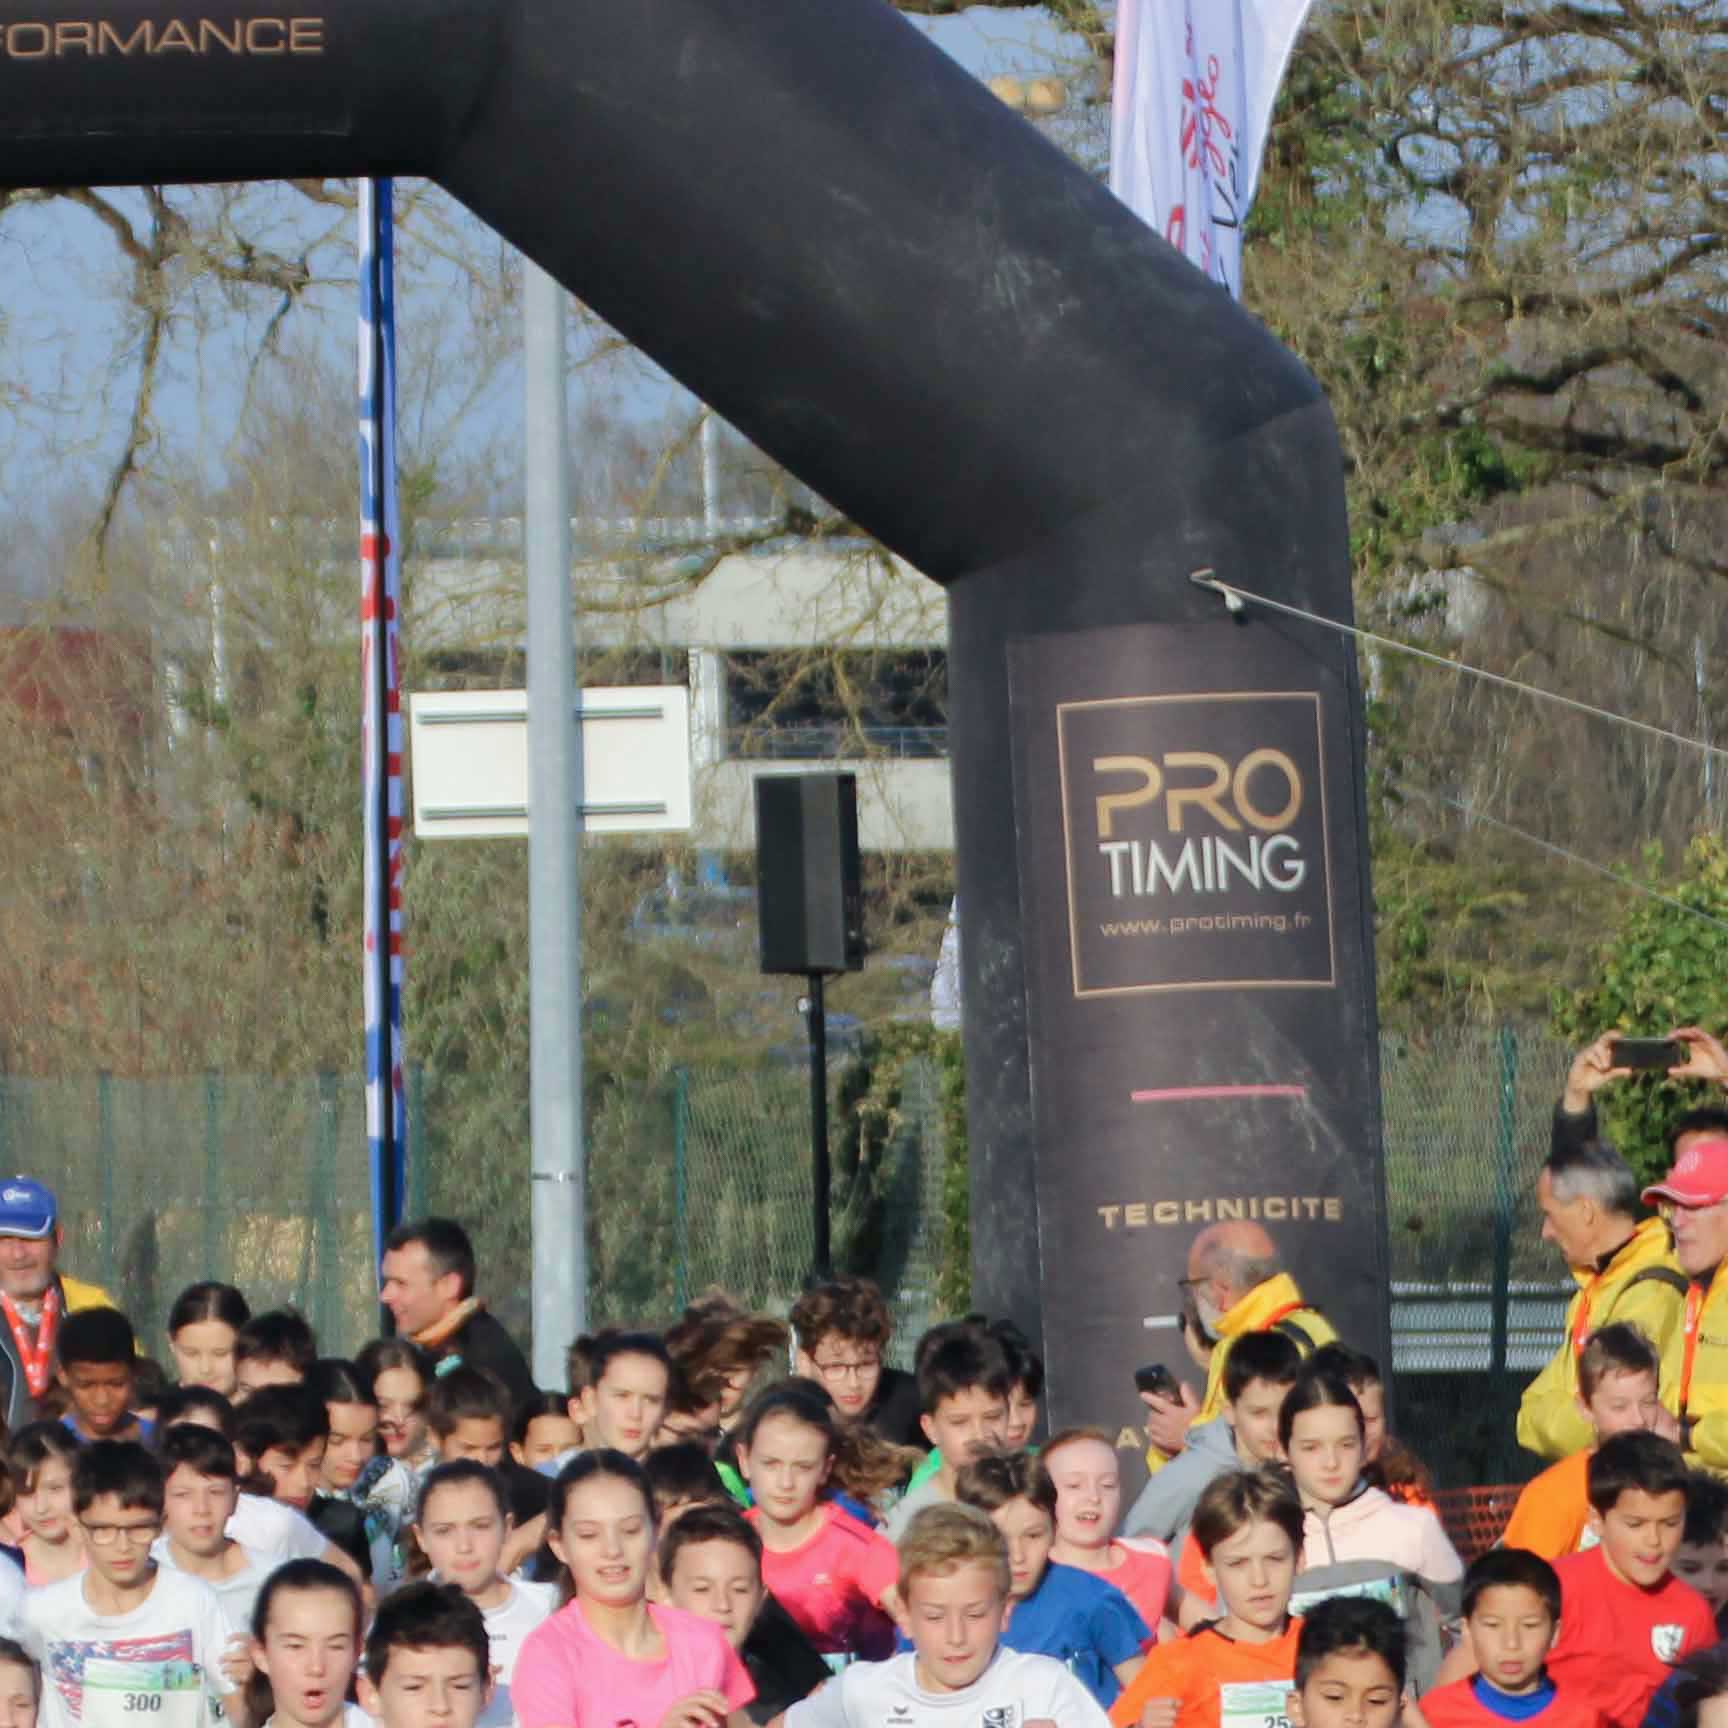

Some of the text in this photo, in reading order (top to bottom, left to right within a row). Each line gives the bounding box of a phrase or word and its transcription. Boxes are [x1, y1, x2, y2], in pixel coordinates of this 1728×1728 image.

[1093, 747, 1305, 837] PRO
[1099, 834, 1308, 896] TIMING
[1098, 913, 1311, 937] www.protiming.fr
[1097, 1196, 1343, 1228] TECHNICITE
[123, 1693, 162, 1713] 300
